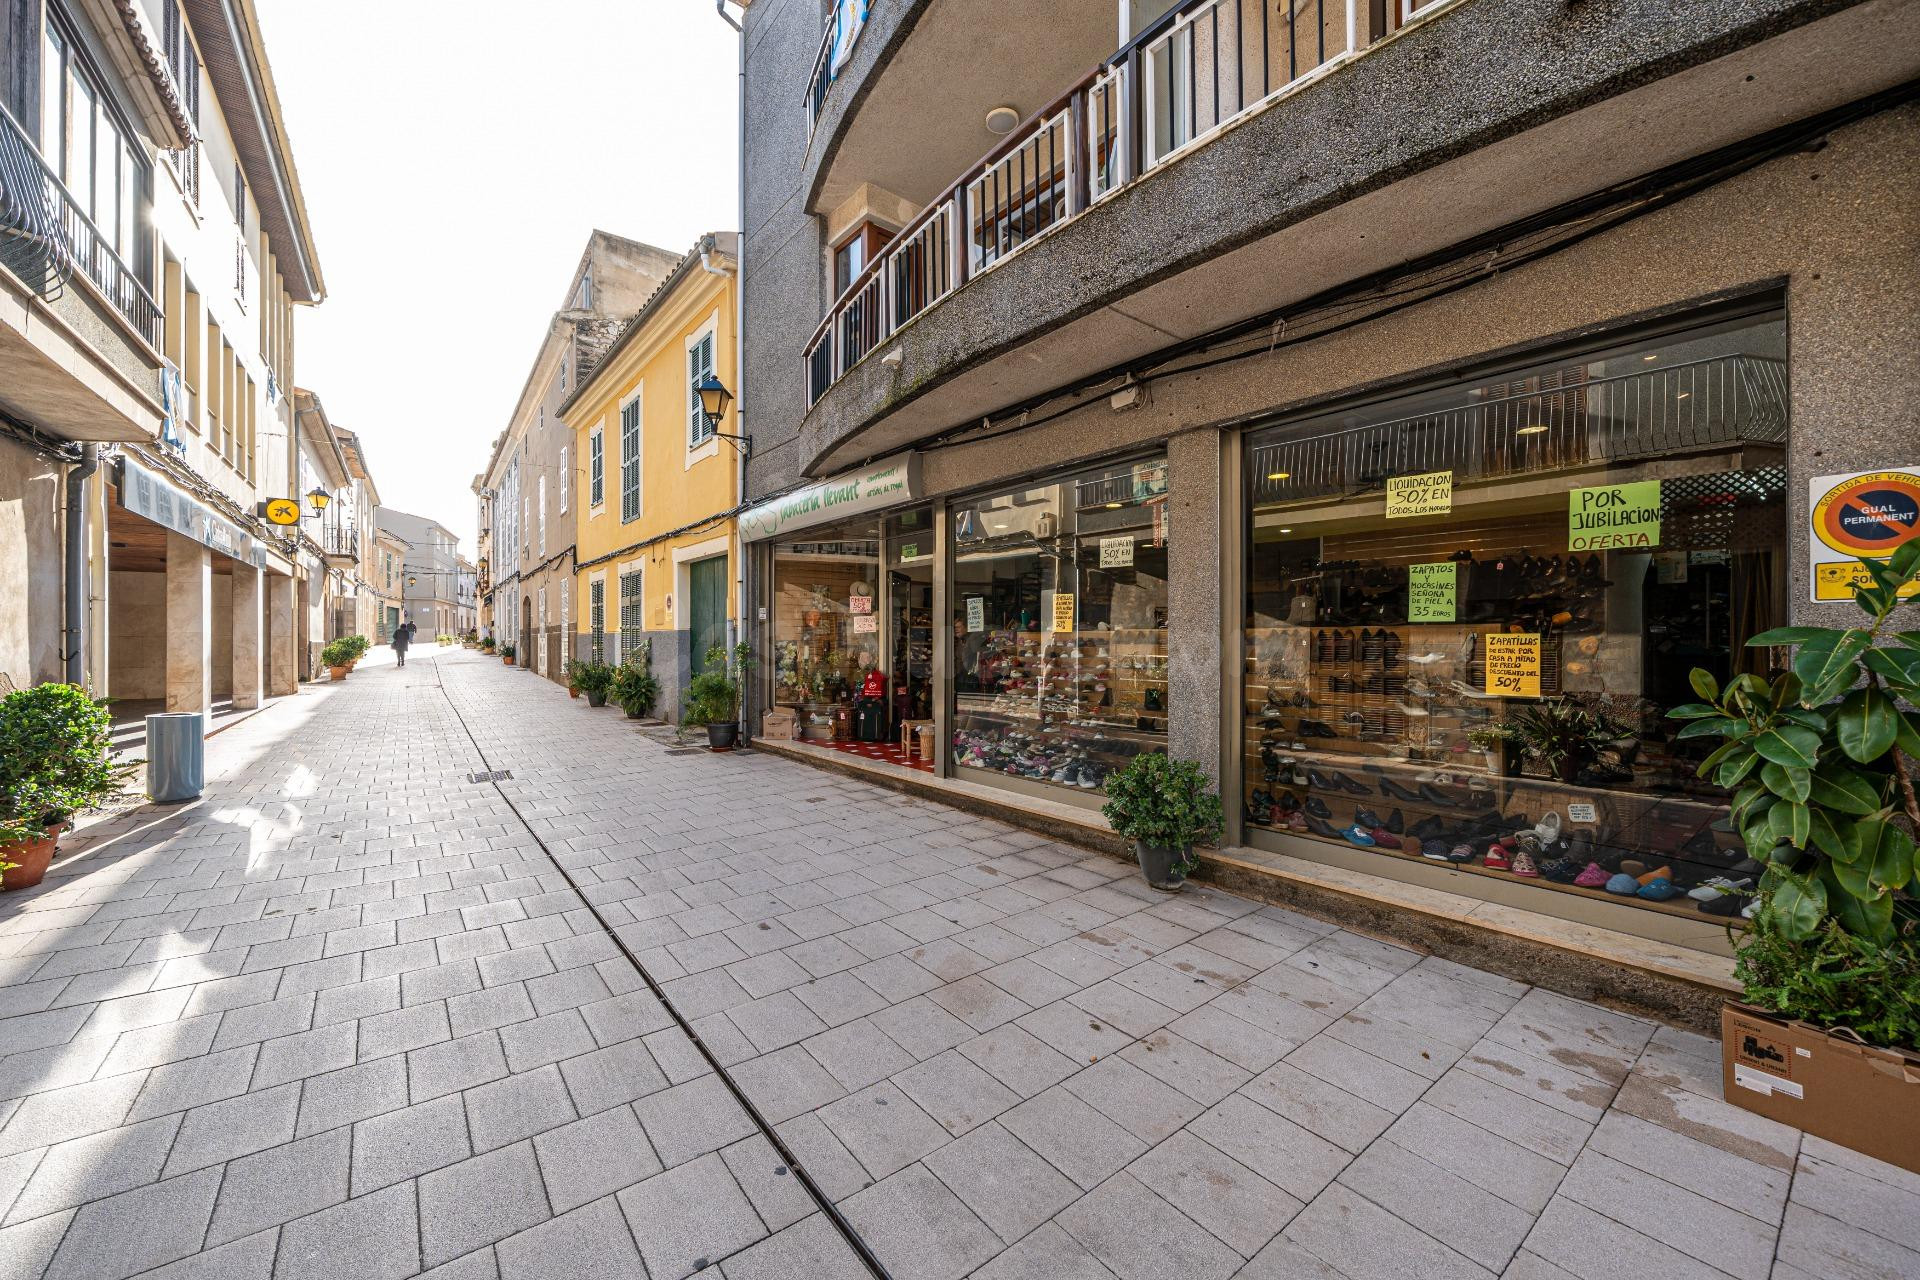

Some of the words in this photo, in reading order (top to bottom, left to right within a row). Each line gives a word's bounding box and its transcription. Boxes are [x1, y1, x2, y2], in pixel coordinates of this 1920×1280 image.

[1820, 479, 1861, 507] SORTIDA
[1865, 474, 1881, 483] DE
[1395, 488, 1430, 504] 50%
[1432, 488, 1450, 500] EN
[1582, 489, 1627, 511] POR
[1388, 506, 1413, 515] TODOS
[1415, 506, 1428, 514] LOS
[1861, 504, 1896, 514] GUAL
[1844, 512, 1914, 525] PERMANENT
[1573, 533, 1650, 549] OFERTA
[1121, 548, 1131, 556] EN
[1411, 565, 1454, 574] ZAPATOS
[1424, 575, 1430, 583] Y
[1411, 581, 1454, 590] MOCASINES
[1411, 589, 1445, 597] SEÑORA
[1413, 606, 1430, 616] 35
[1489, 635, 1538, 646] ZAPATILLAS
[1518, 647, 1535, 655] POR
[1495, 676, 1521, 692] 50%
